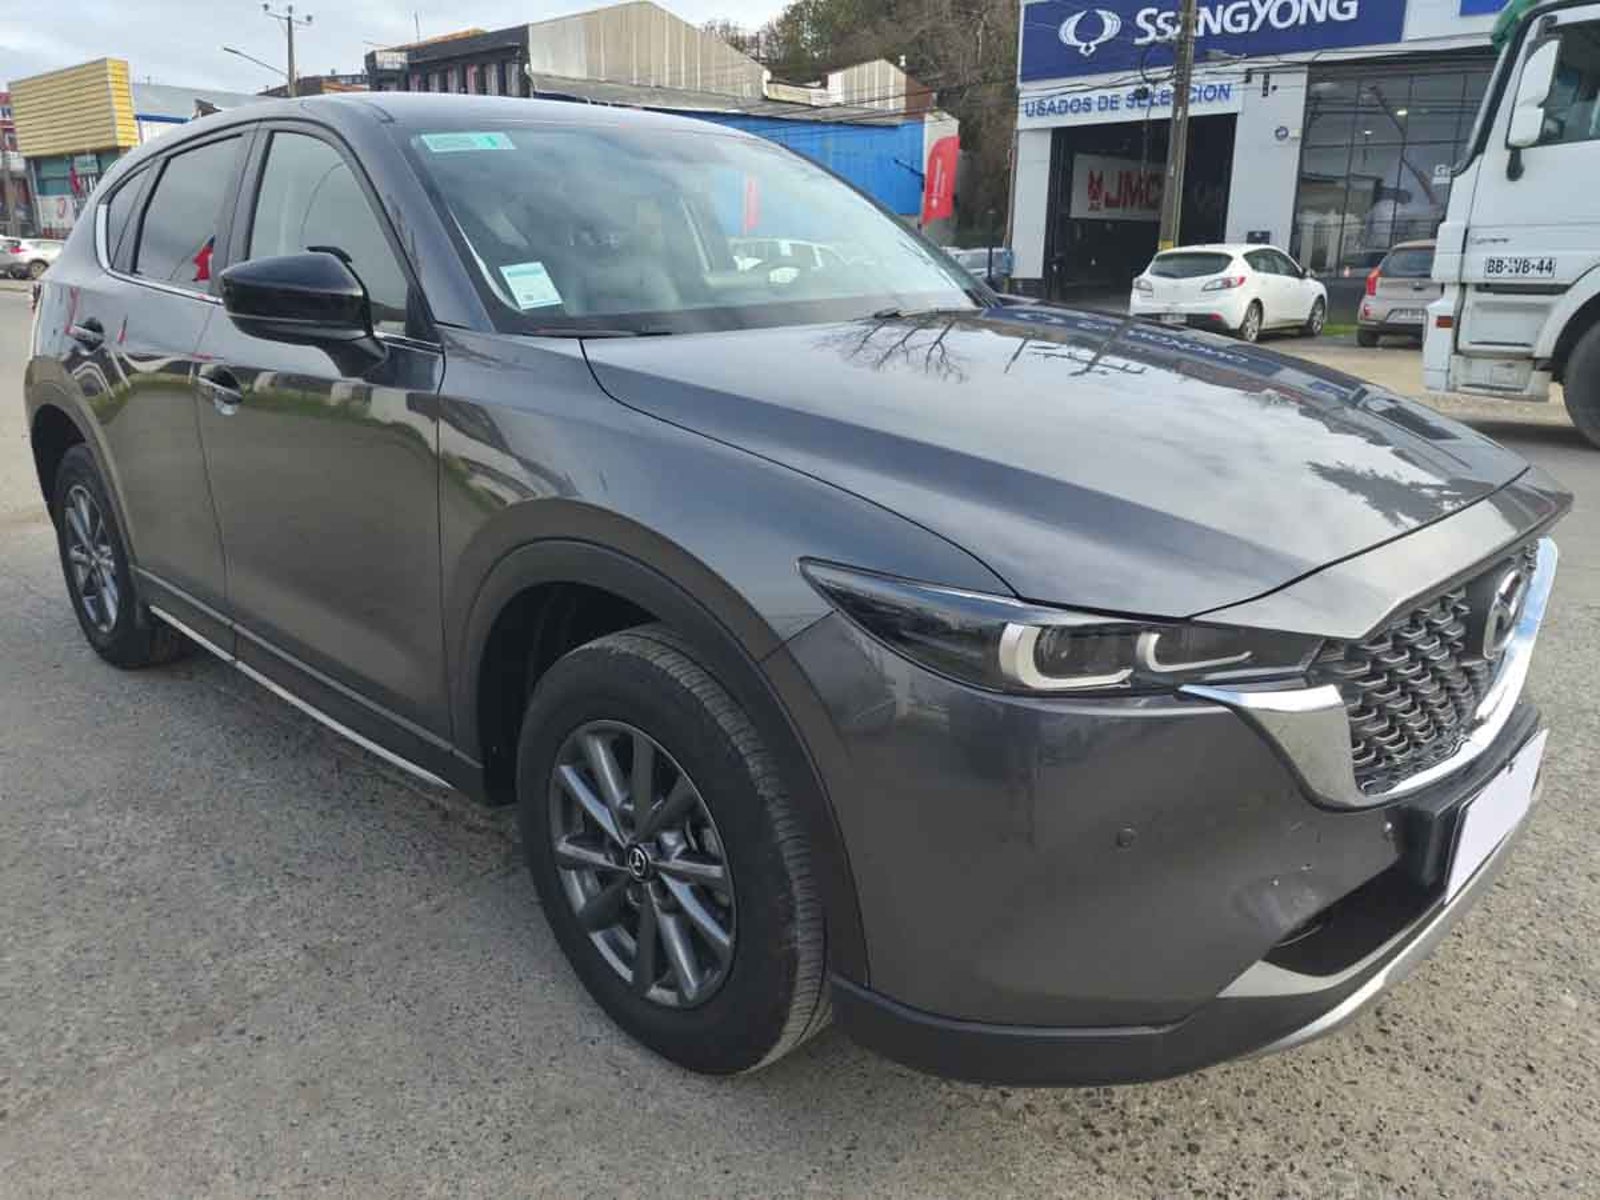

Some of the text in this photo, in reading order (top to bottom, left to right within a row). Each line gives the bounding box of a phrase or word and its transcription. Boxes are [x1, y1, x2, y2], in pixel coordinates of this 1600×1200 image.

[1134, 0, 1359, 44] SSNGYONG
[1025, 84, 1232, 117] USADOS DE SELECION
